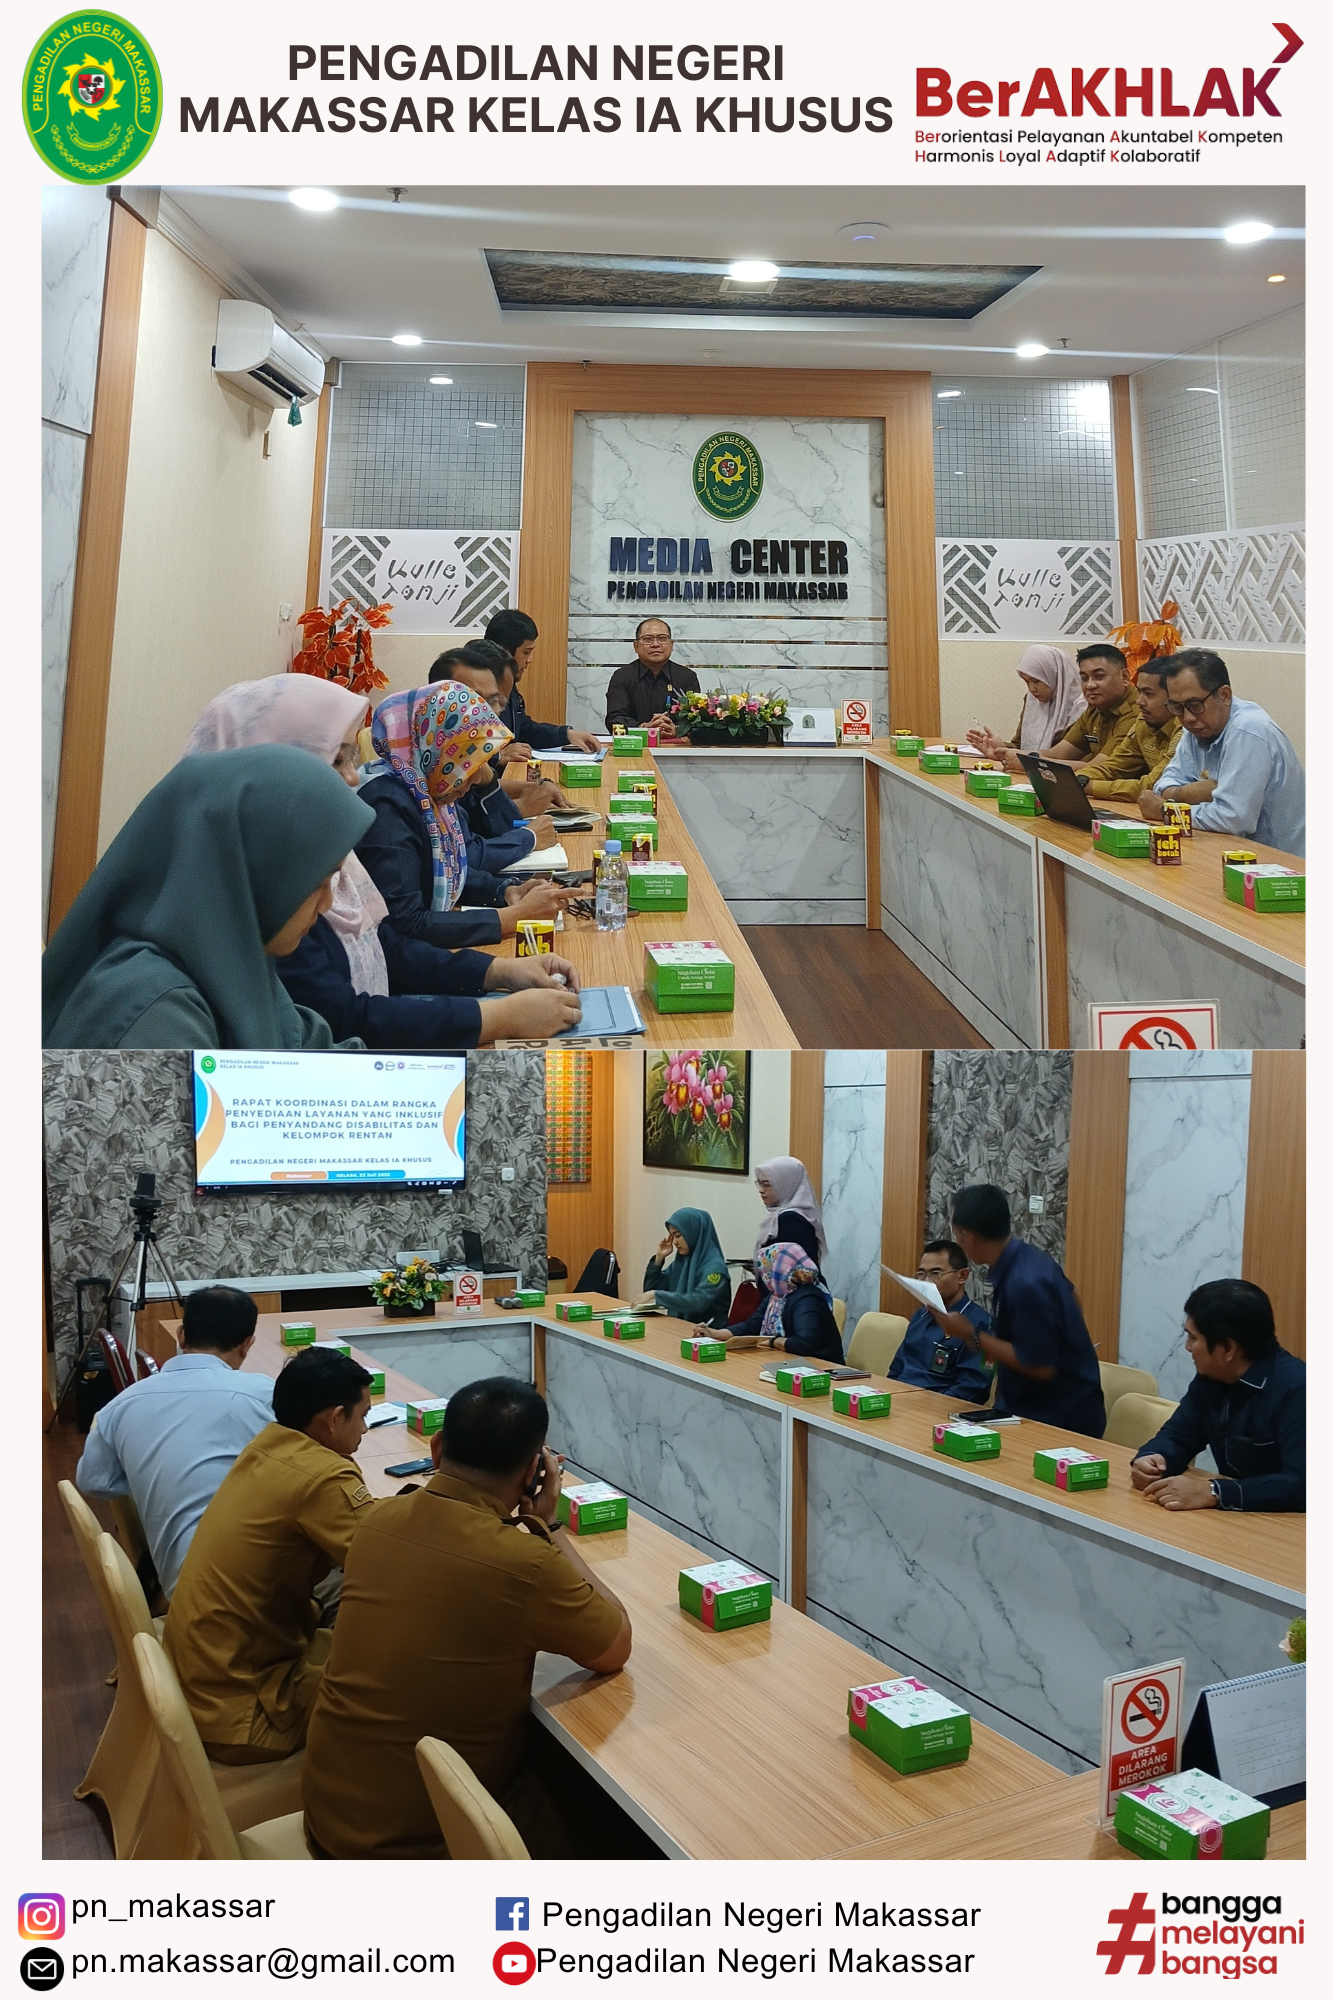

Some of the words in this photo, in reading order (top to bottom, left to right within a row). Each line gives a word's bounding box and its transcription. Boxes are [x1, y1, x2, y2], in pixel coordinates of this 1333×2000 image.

[698, 439, 718, 482] PENGADILAN
[719, 436, 747, 448] NEGERI
[745, 447, 758, 487] MAKASSAR
[610, 537, 713, 574] MEDIA
[730, 539, 849, 575] CENTER
[388, 560, 457, 579] Kulle
[998, 568, 1062, 588] Kulle
[607, 580, 703, 600] PENGADILAN
[707, 581, 760, 600] NEGERI
[764, 582, 848, 601] MAKASSAR
[1157, 836, 1179, 850] teh
[232, 1098, 271, 1107] RAPAT
[276, 1099, 347, 1107] KOORDINASI
[351, 1100, 389, 1108] DALAM
[392, 1100, 437, 1108] RANGKA
[225, 1109, 302, 1118] PENYEDIAAN
[306, 1110, 359, 1118] LAYANAN
[362, 1110, 392, 1118] YANG
[396, 1111, 443, 1119] INKLUSIF
[231, 1120, 259, 1129] BAGI
[263, 1120, 343, 1129] PENYANDANG
[346, 1121, 413, 1129] DISABILITAS
[416, 1121, 439, 1129] DAN
[283, 1131, 345, 1139] KELOMPOK
[349, 1131, 393, 1139] RENTAN
[1131, 1745, 1157, 1761] AREA
[1118, 1752, 1168, 1776] DILARANG
[1118, 1763, 1167, 1787] MEROKOK
